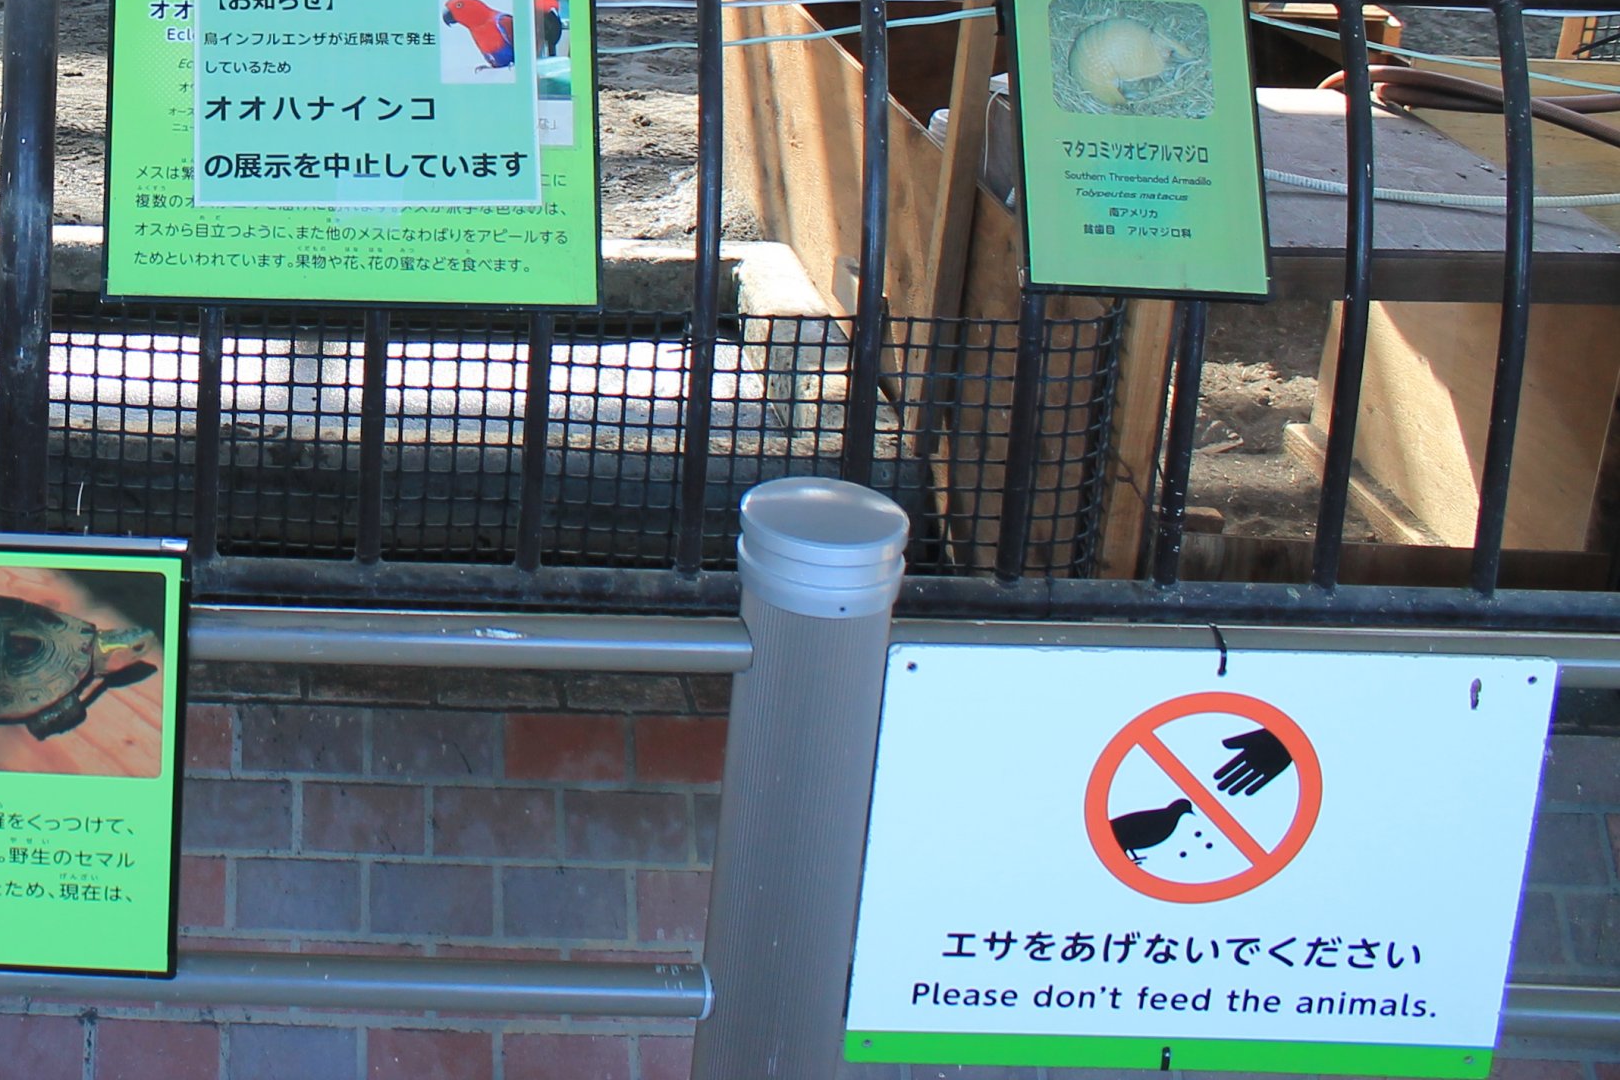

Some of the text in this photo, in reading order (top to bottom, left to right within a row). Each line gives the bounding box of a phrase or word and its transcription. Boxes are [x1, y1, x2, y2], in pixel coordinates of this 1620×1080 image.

[167, 27, 195, 41] Ecl
[204, 31, 436, 47] 鳥インフルエンザが近隣県で発生
[205, 60, 291, 74] しているため
[204, 95, 435, 121] オオハナインコ
[1062, 140, 1209, 163] マタコミツオビアルマジロ
[205, 151, 528, 178] の展示を中止しています
[1064, 170, 1107, 182] Southern
[1172, 177, 1212, 187] Armadillo
[1075, 188, 1188, 201] Tolypeutes matacus
[1109, 207, 1159, 219] 南アメリカ
[1128, 226, 1192, 239] アルマジロ科
[942, 930, 1421, 969] エサをあげないでください
[912, 982, 1436, 1018] Please don't feed the animals.
